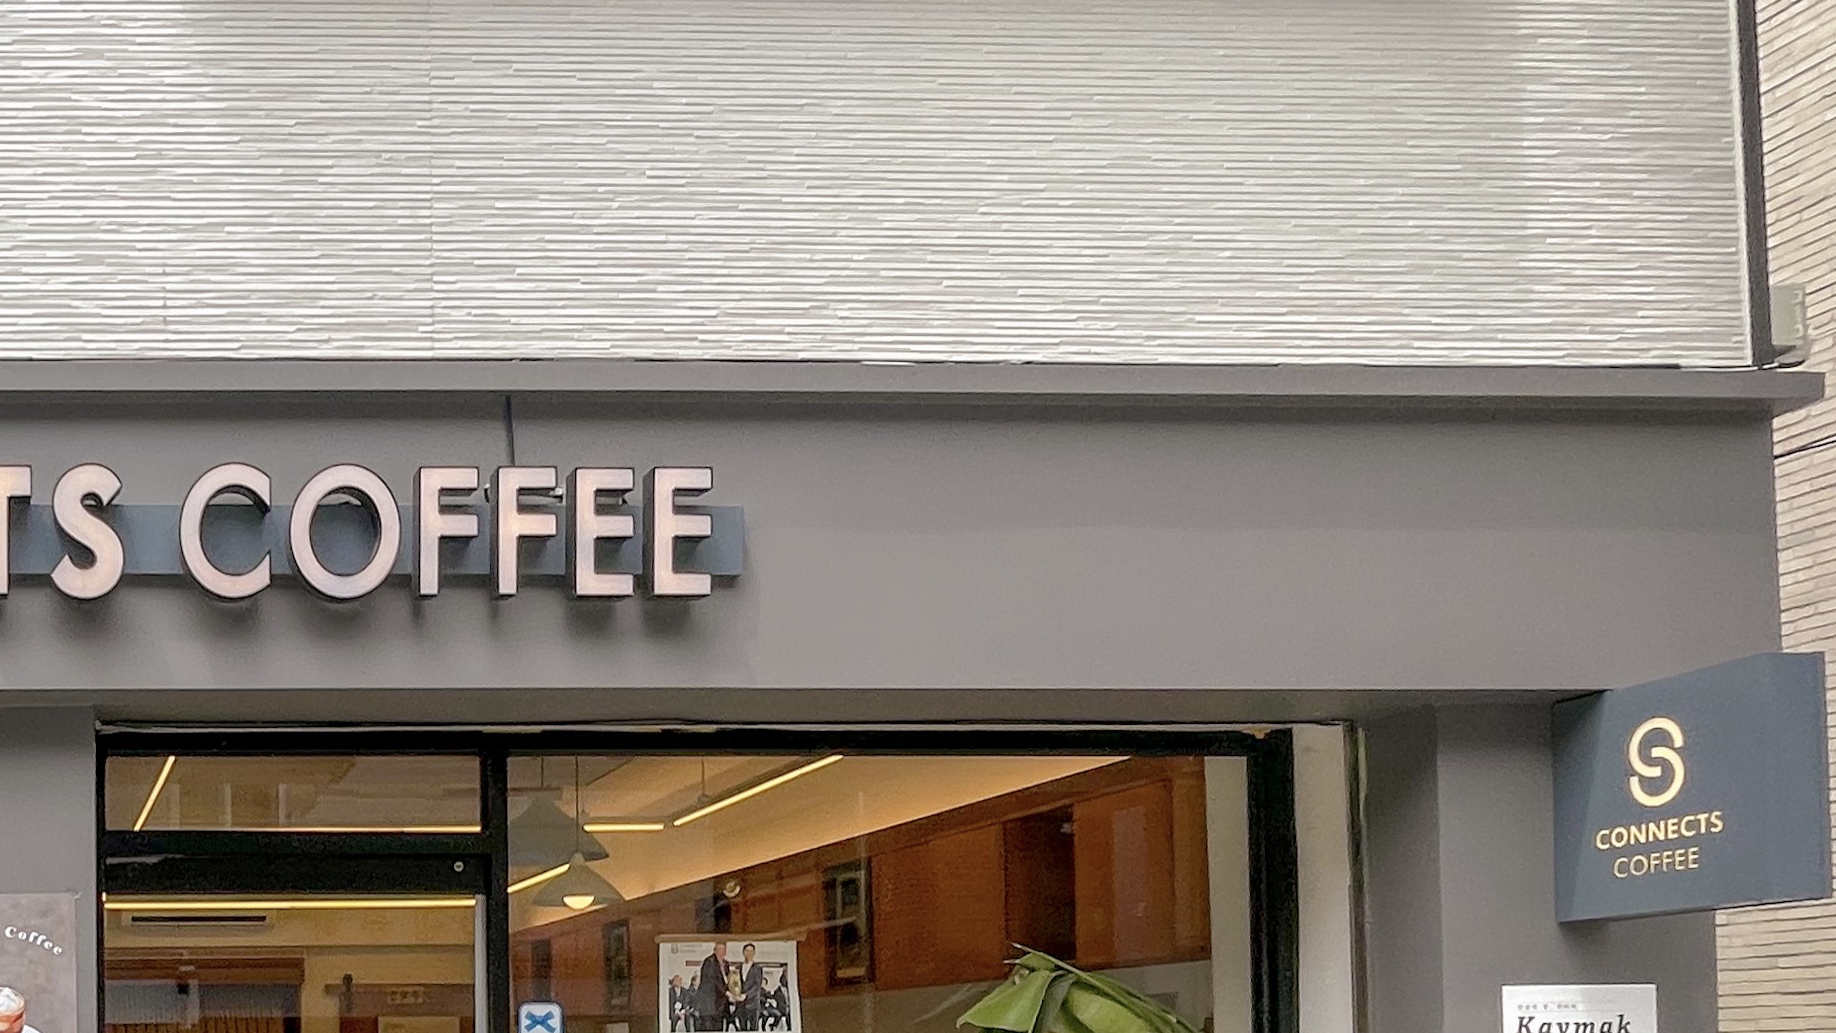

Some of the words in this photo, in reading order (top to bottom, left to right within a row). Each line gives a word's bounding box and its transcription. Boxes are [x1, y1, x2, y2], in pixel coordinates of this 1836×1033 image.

[177, 462, 714, 599] COFFEE
[1594, 810, 1724, 850] CONNECTS
[1613, 846, 1700, 879] COFFEE
[4, 926, 63, 956] Coffee
